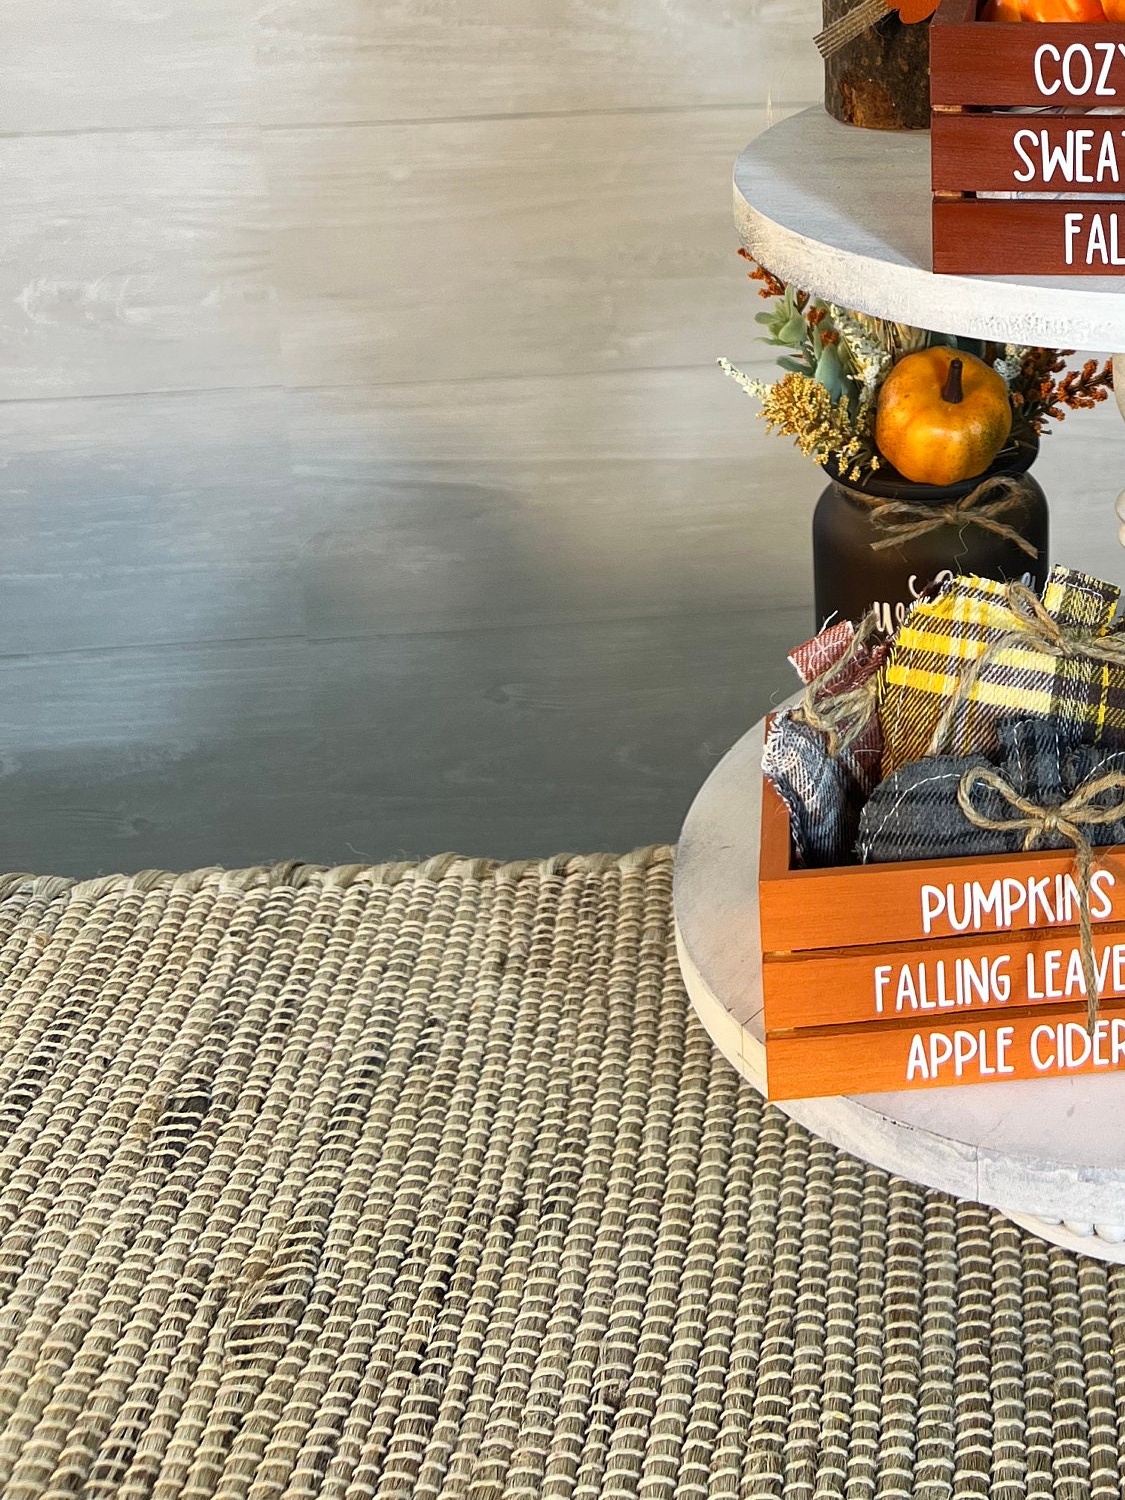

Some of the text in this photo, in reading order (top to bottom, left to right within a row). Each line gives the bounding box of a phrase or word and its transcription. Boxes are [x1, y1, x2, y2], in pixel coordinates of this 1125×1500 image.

[921, 869, 1116, 934] PUMPKINS
[874, 955, 1011, 1013] FALLING
[906, 1026, 1015, 1081] APPLE
